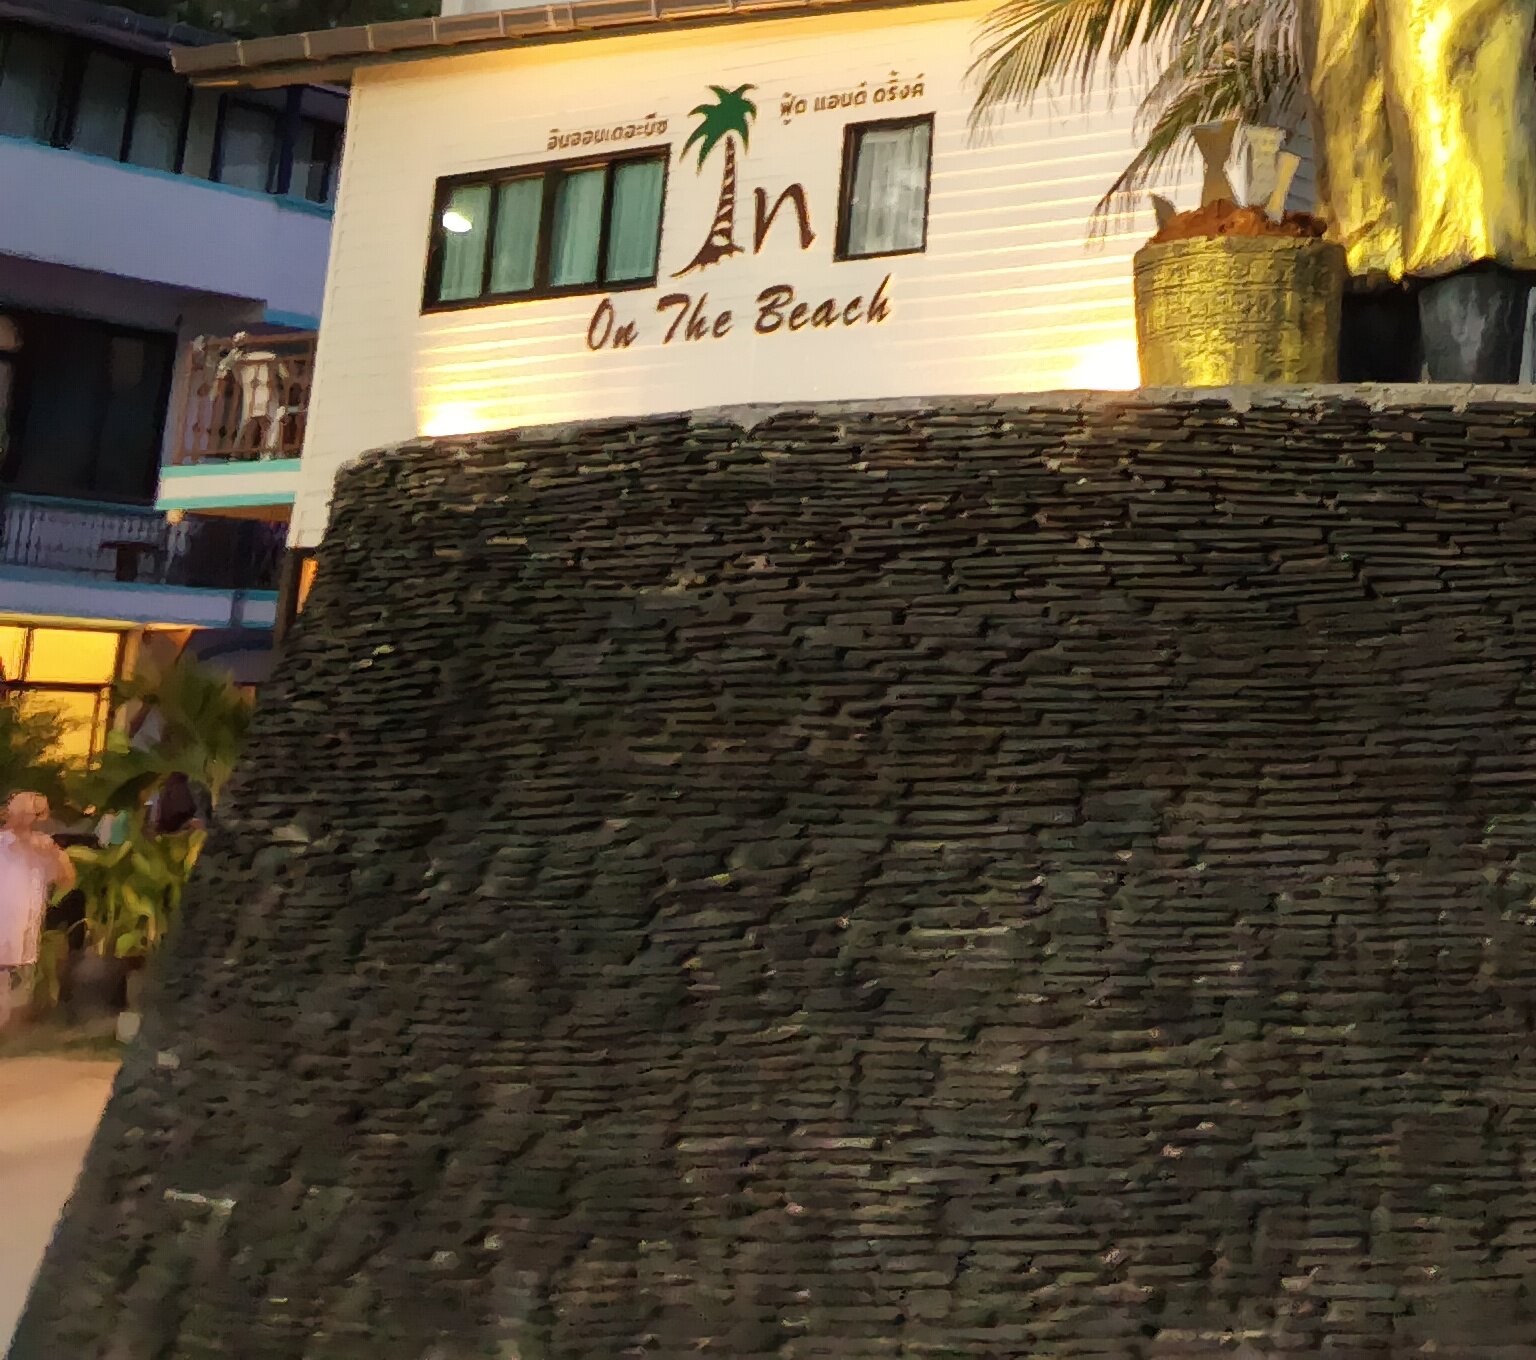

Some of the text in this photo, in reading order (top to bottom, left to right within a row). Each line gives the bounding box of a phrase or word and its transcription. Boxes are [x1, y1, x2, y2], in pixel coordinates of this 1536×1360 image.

[586, 272, 893, 351] On The Beach
